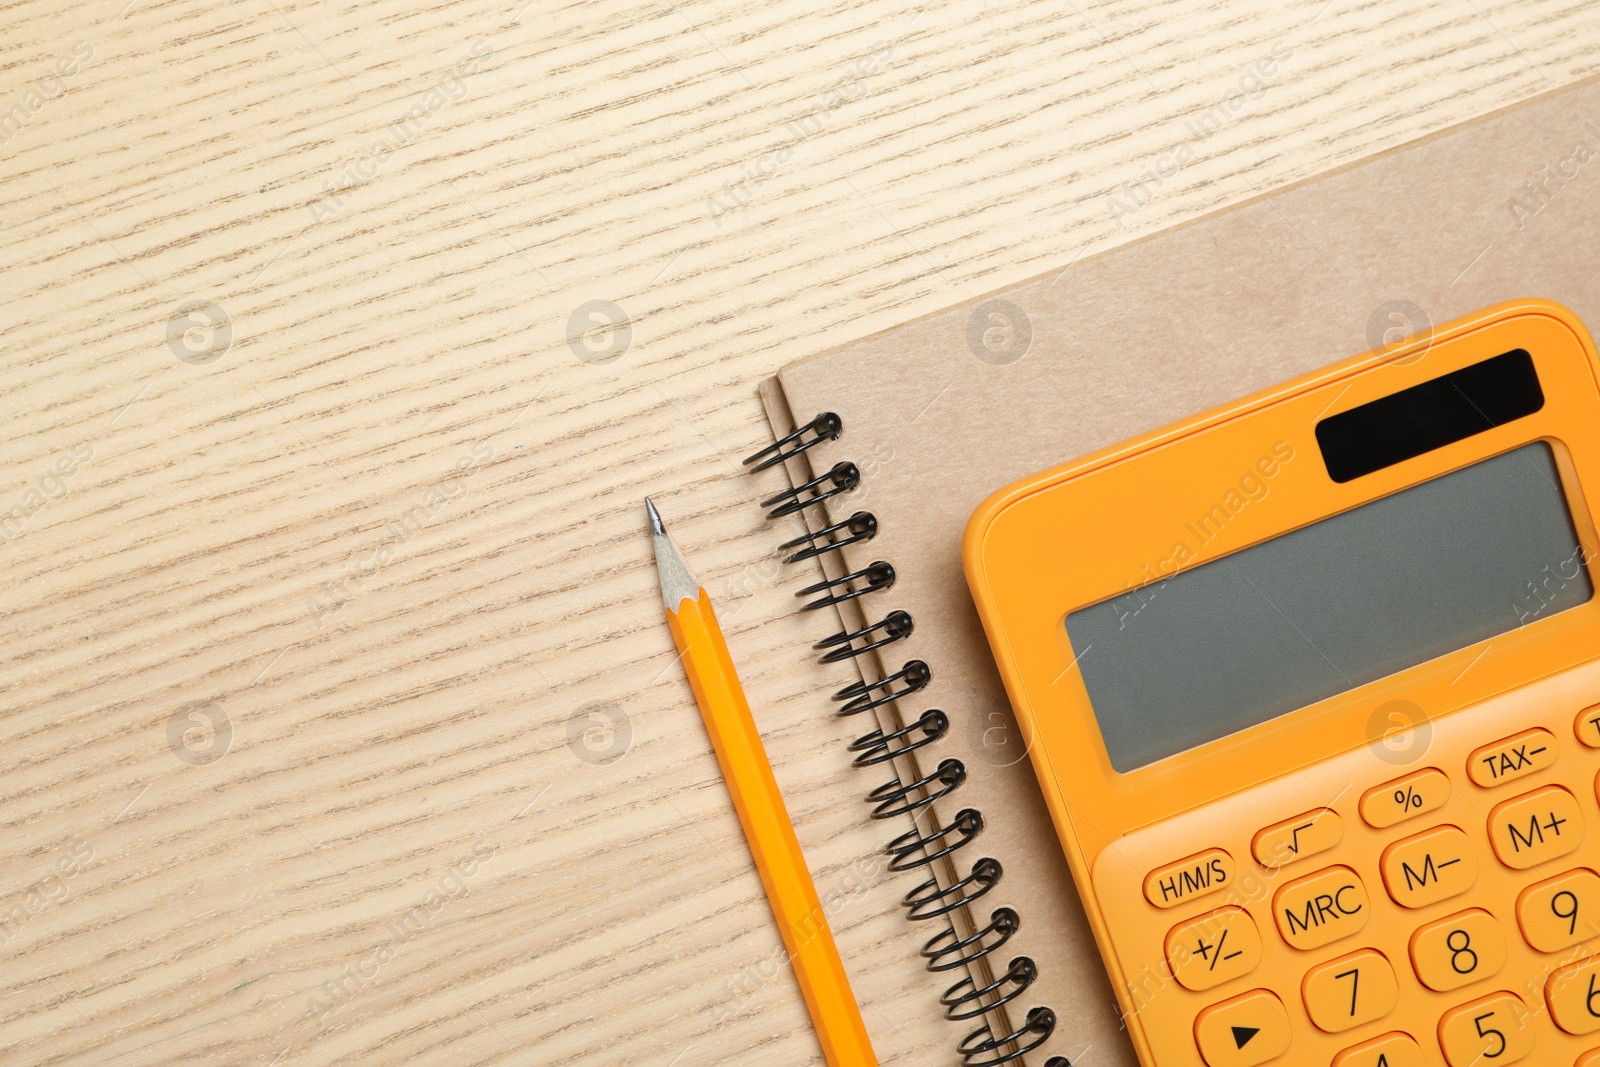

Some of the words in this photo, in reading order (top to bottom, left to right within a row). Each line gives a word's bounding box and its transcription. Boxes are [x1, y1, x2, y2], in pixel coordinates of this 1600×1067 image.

[1483, 745, 1546, 778] TAX-
[1394, 786, 1423, 813] %
[1508, 813, 1566, 852] M+
[1159, 859, 1226, 902] H/M/S
[1402, 854, 1460, 891] M-
[1285, 884, 1362, 935] MRC
[1551, 891, 1578, 935] 9
[1447, 930, 1477, 974] 8
[1335, 969, 1358, 1016] 7
[1475, 1012, 1505, 1058] 5
